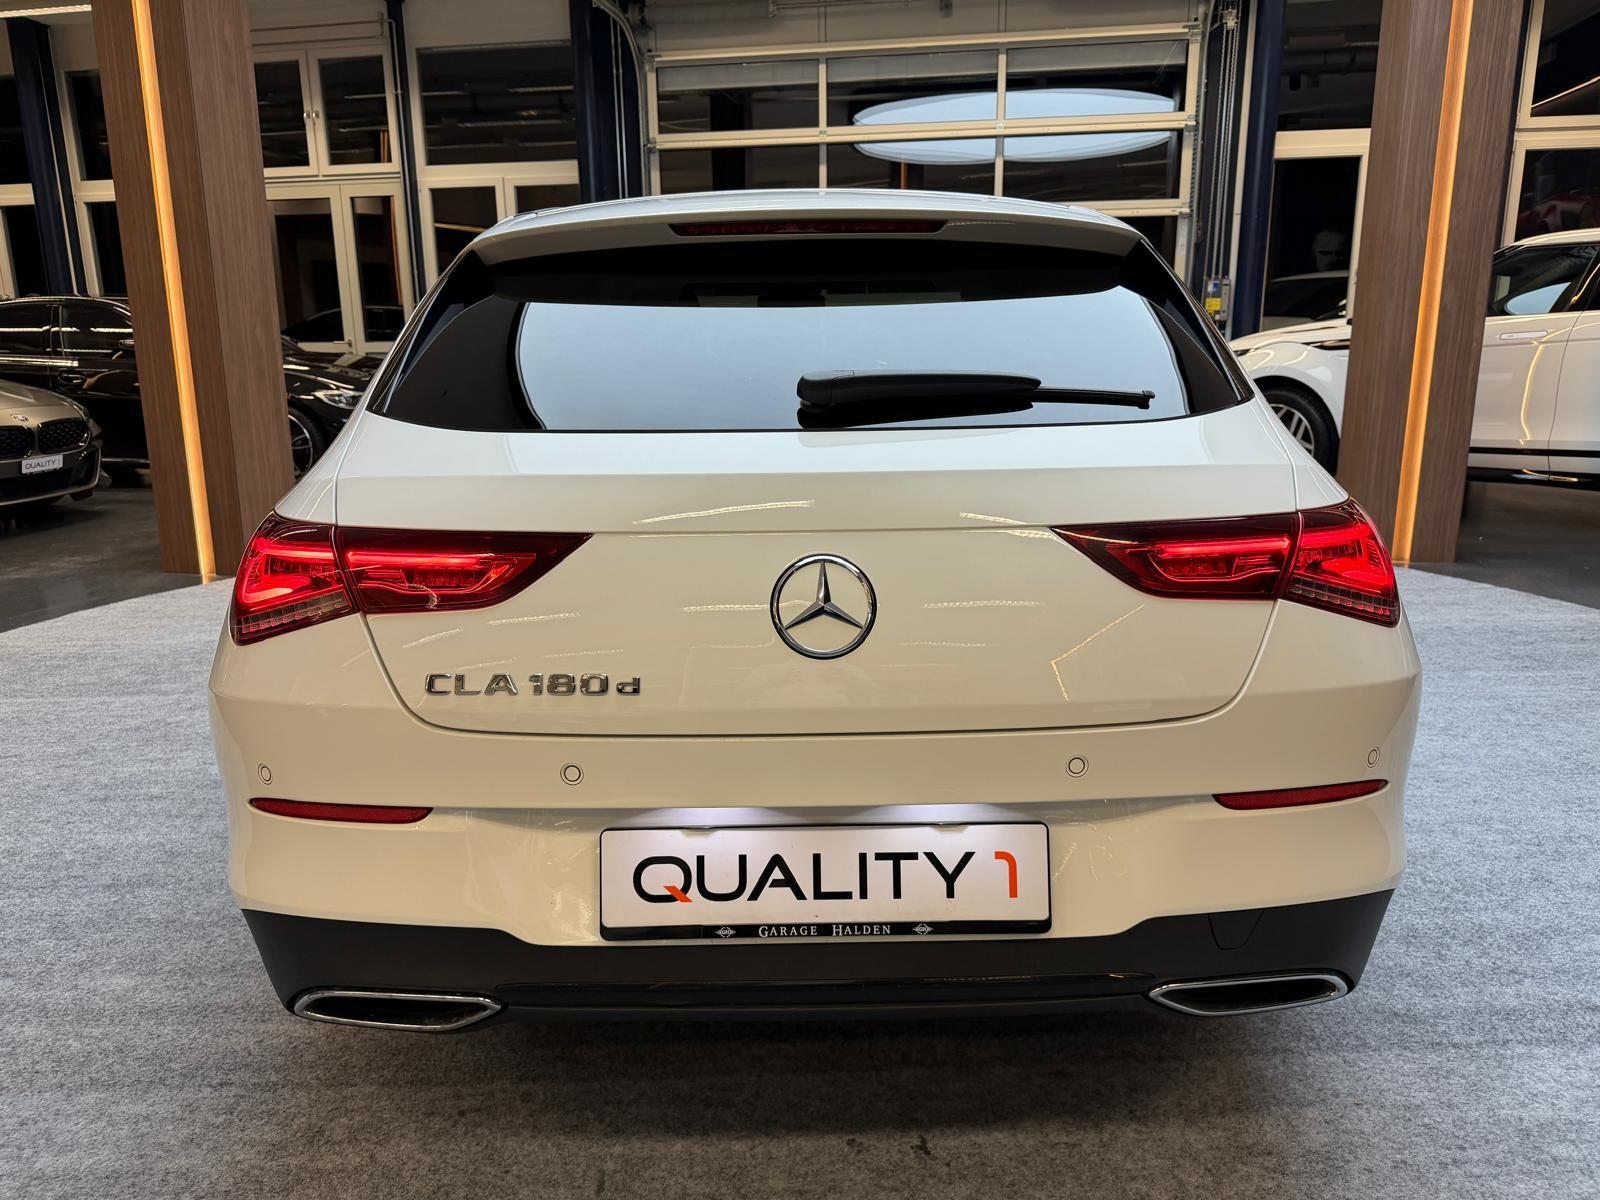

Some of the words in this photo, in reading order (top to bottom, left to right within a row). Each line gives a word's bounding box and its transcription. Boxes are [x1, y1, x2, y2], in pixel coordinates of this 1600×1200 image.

[25, 459, 56, 470] QUALITY
[425, 673, 518, 696] CLA
[633, 851, 976, 903] QUALITY
[994, 851, 1018, 899] 1
[758, 925, 818, 938] GARAGE
[832, 924, 891, 936] HALDEN
